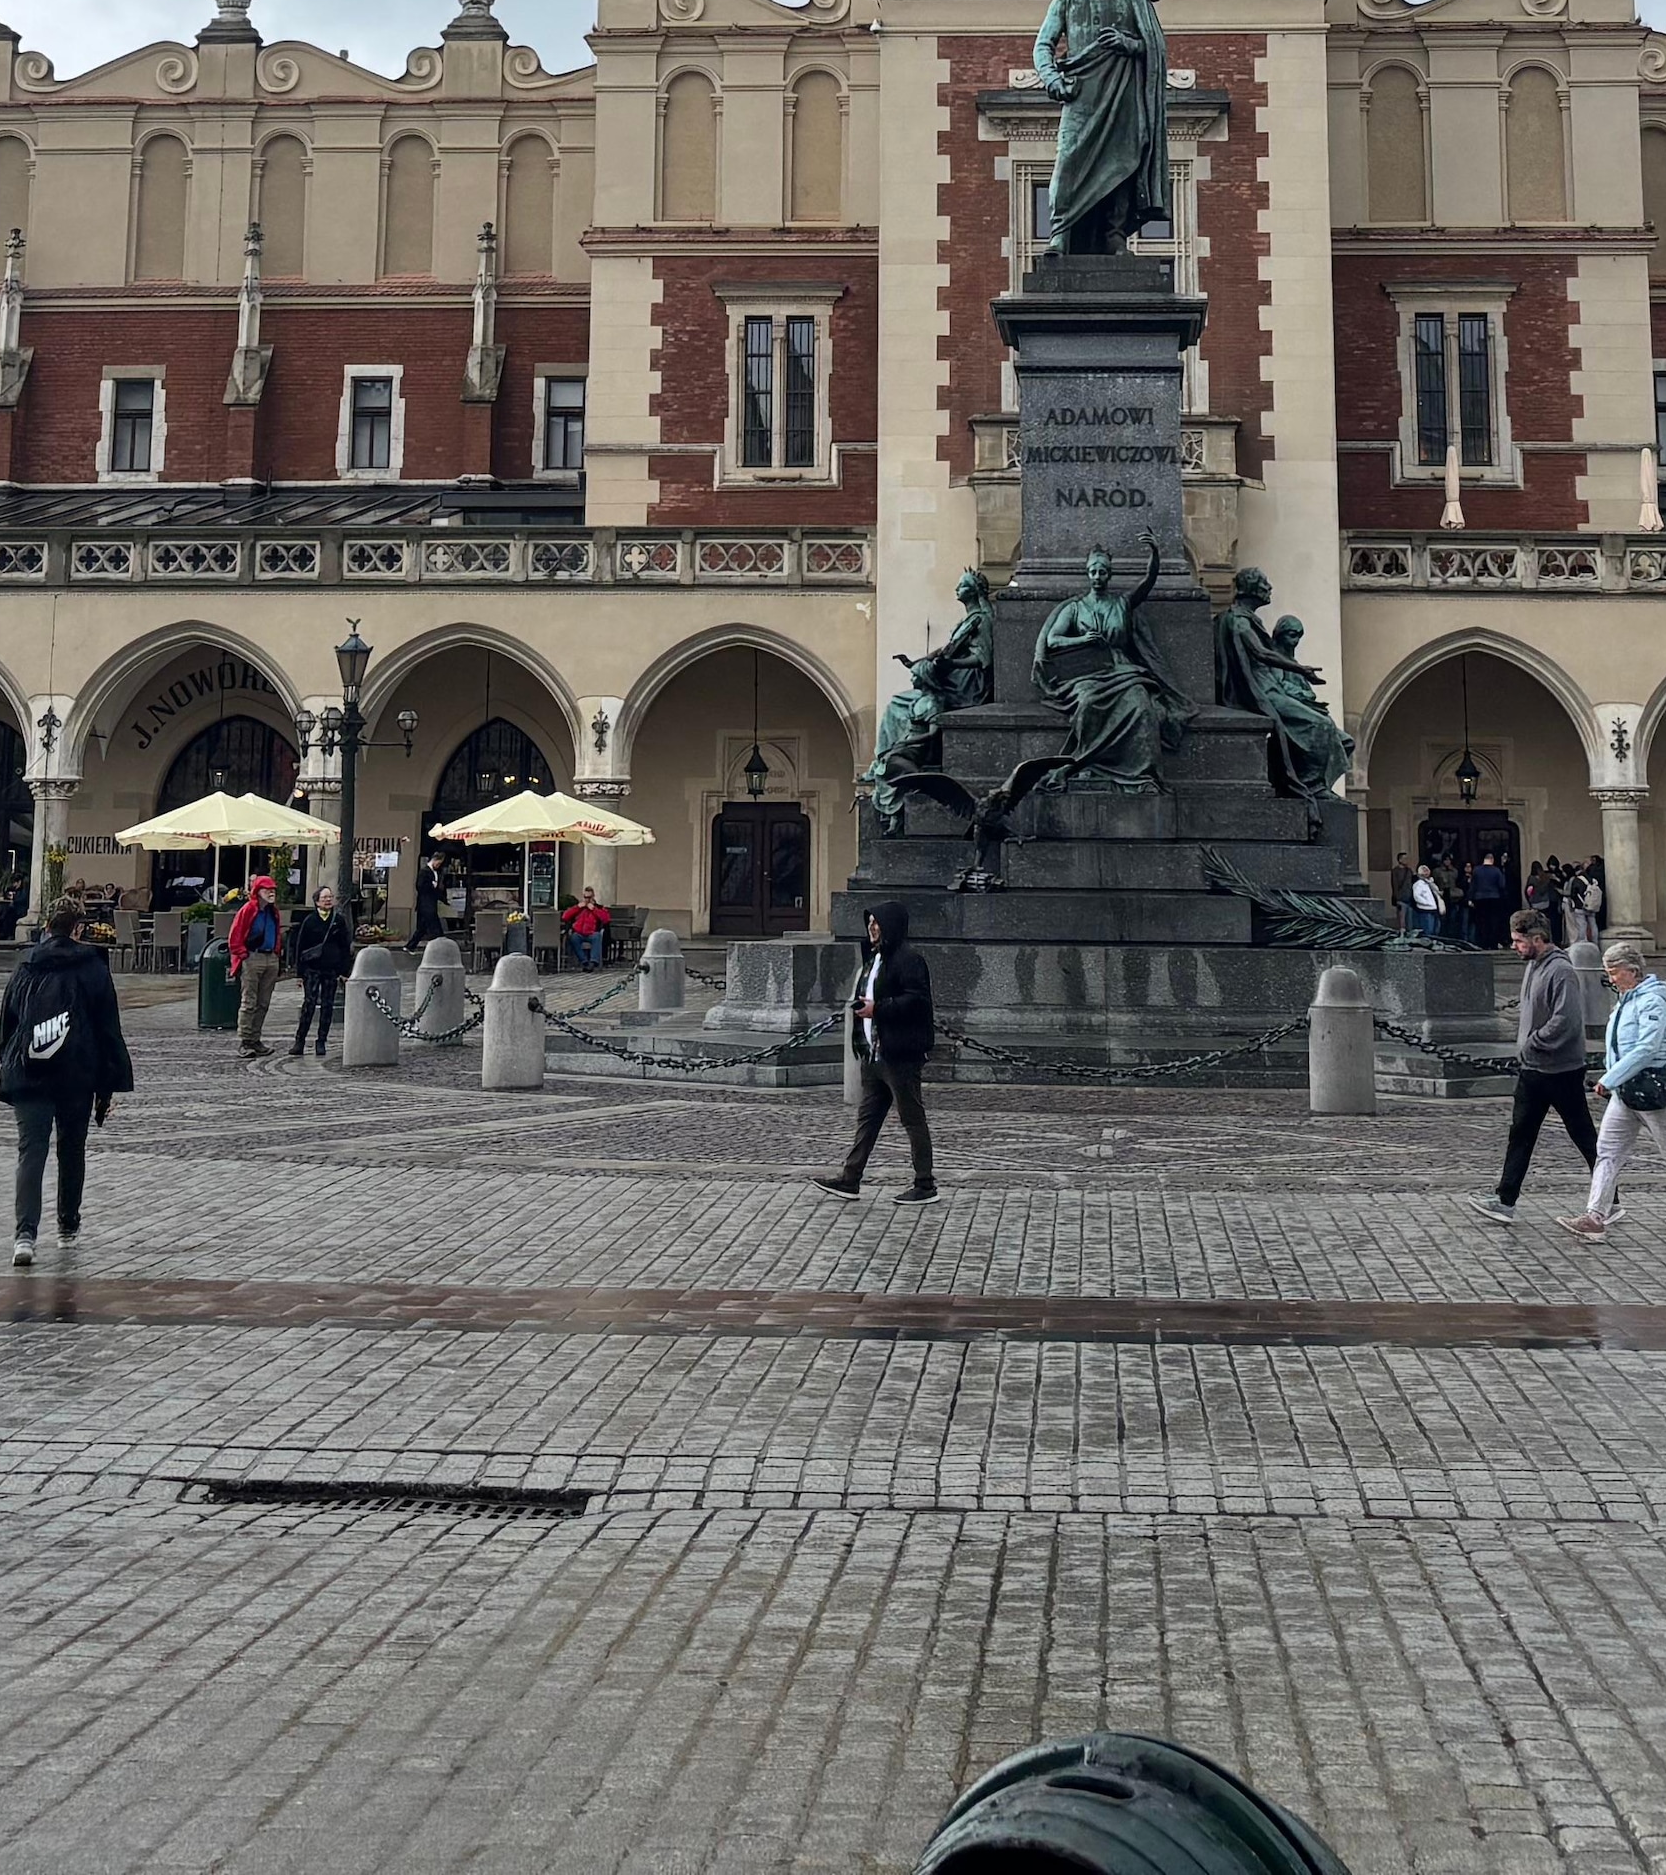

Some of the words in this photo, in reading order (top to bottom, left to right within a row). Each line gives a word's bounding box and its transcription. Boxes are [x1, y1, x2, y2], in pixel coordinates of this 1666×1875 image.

[1044, 407, 1154, 426] ADAMOWI
[1027, 446, 1177, 464] MICKIEWICZOWI
[1055, 481, 1154, 507] NARÓD.
[33, 1011, 70, 1049] NIKE
